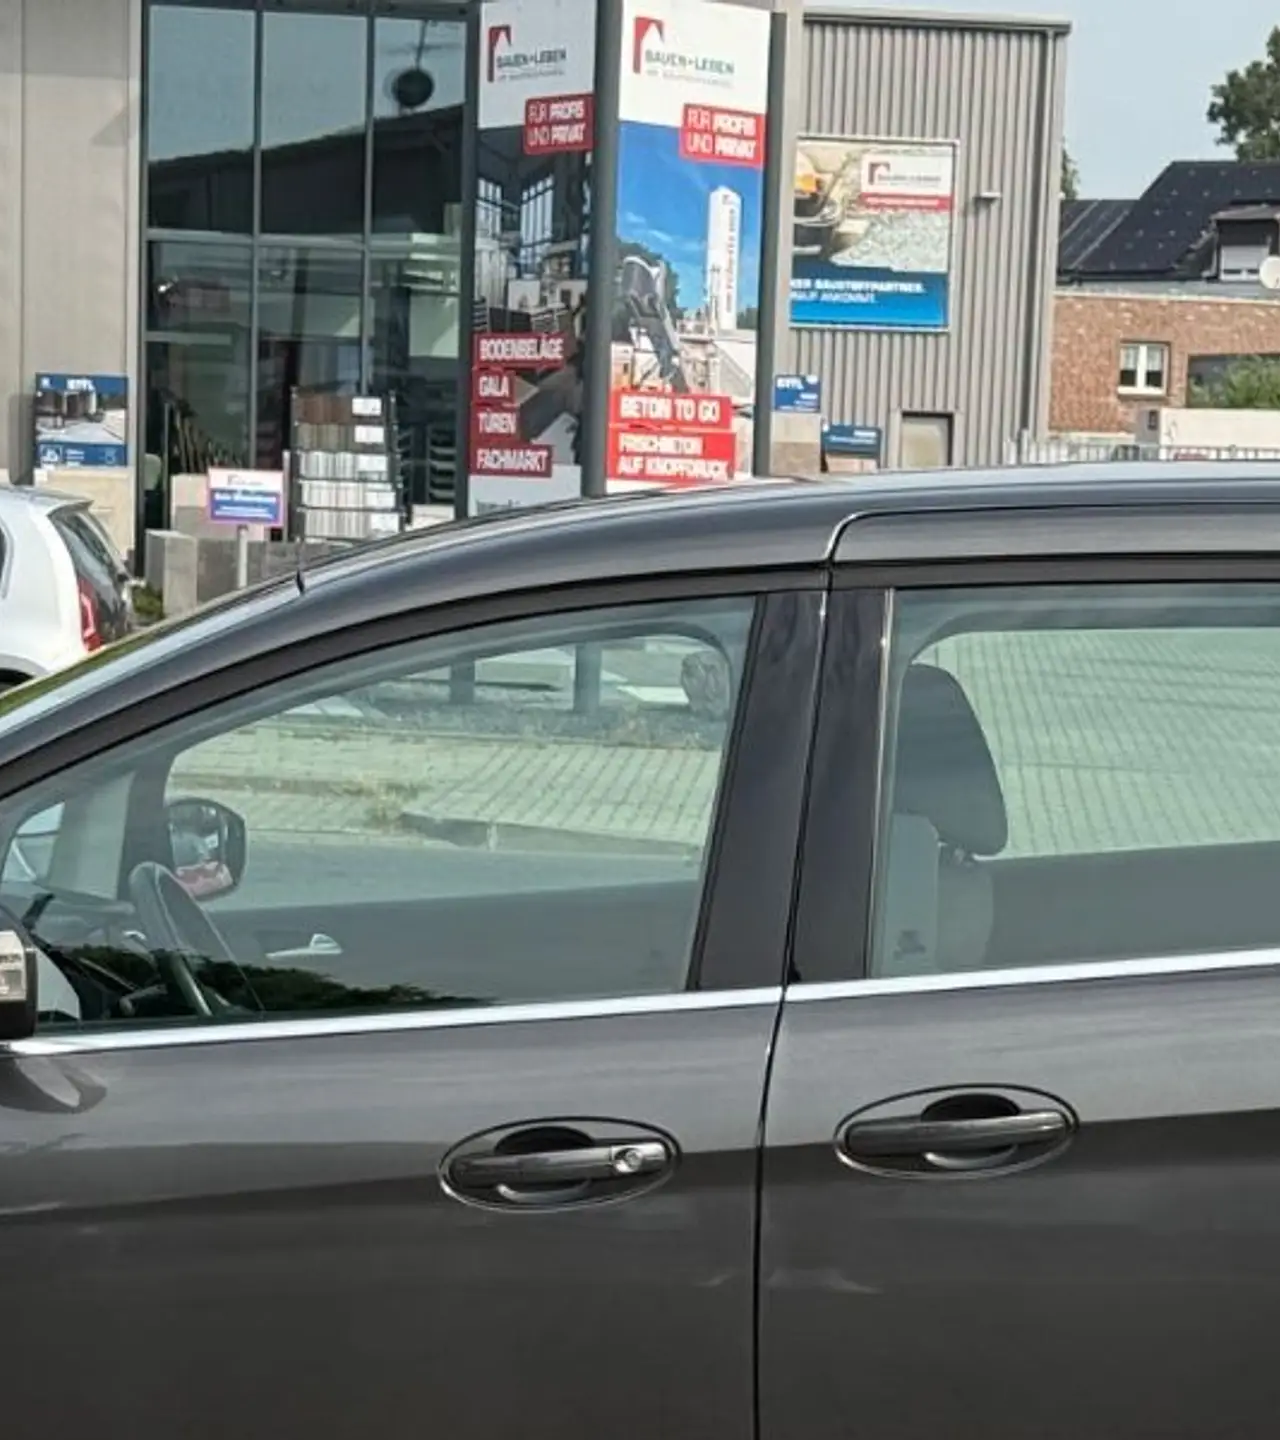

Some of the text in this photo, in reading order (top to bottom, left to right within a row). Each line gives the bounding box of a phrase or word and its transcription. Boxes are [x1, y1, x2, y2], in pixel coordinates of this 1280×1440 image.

[478, 375, 511, 398] GALA
[476, 408, 517, 435] TÜREN
[619, 394, 721, 423] BETON TO GO
[475, 448, 549, 473] FACHMARKT
